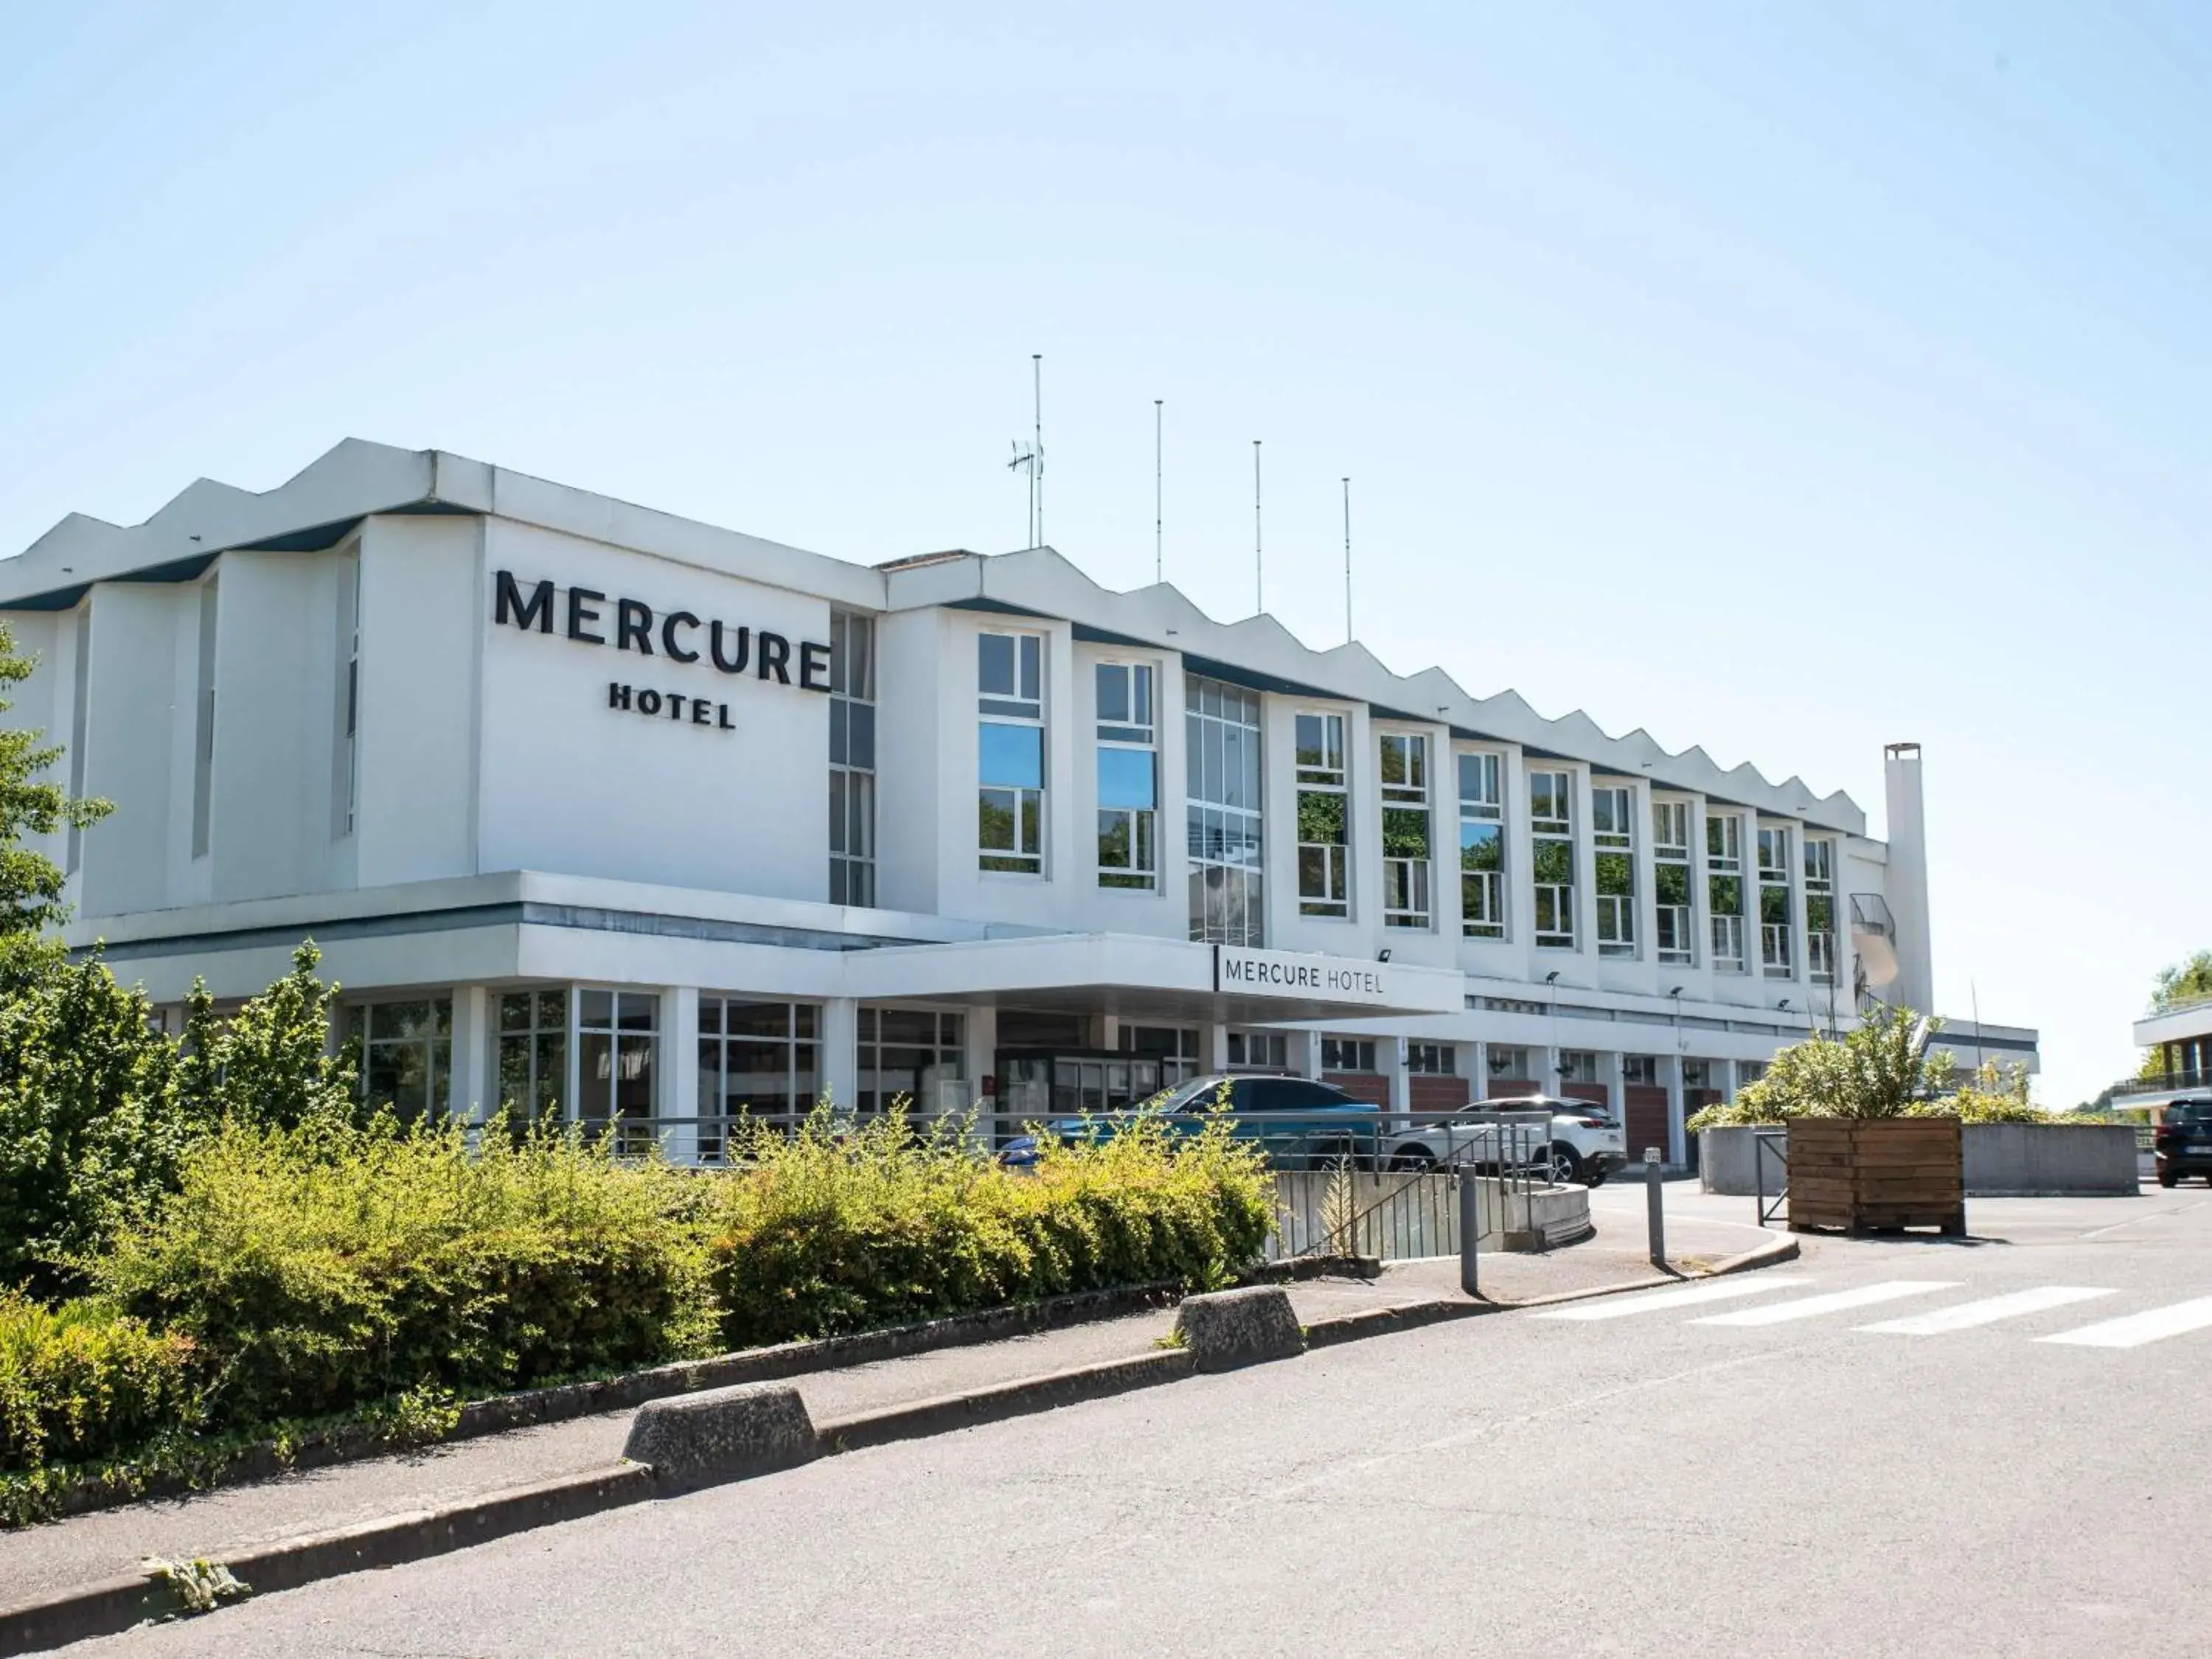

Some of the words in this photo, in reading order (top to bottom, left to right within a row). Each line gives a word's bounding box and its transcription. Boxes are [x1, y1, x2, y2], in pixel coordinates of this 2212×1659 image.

[495, 570, 832, 693] MERCURE
[610, 682, 736, 729] HOTEL
[1226, 959, 1321, 987] MERCURE
[1328, 970, 1384, 993] HOTEL
